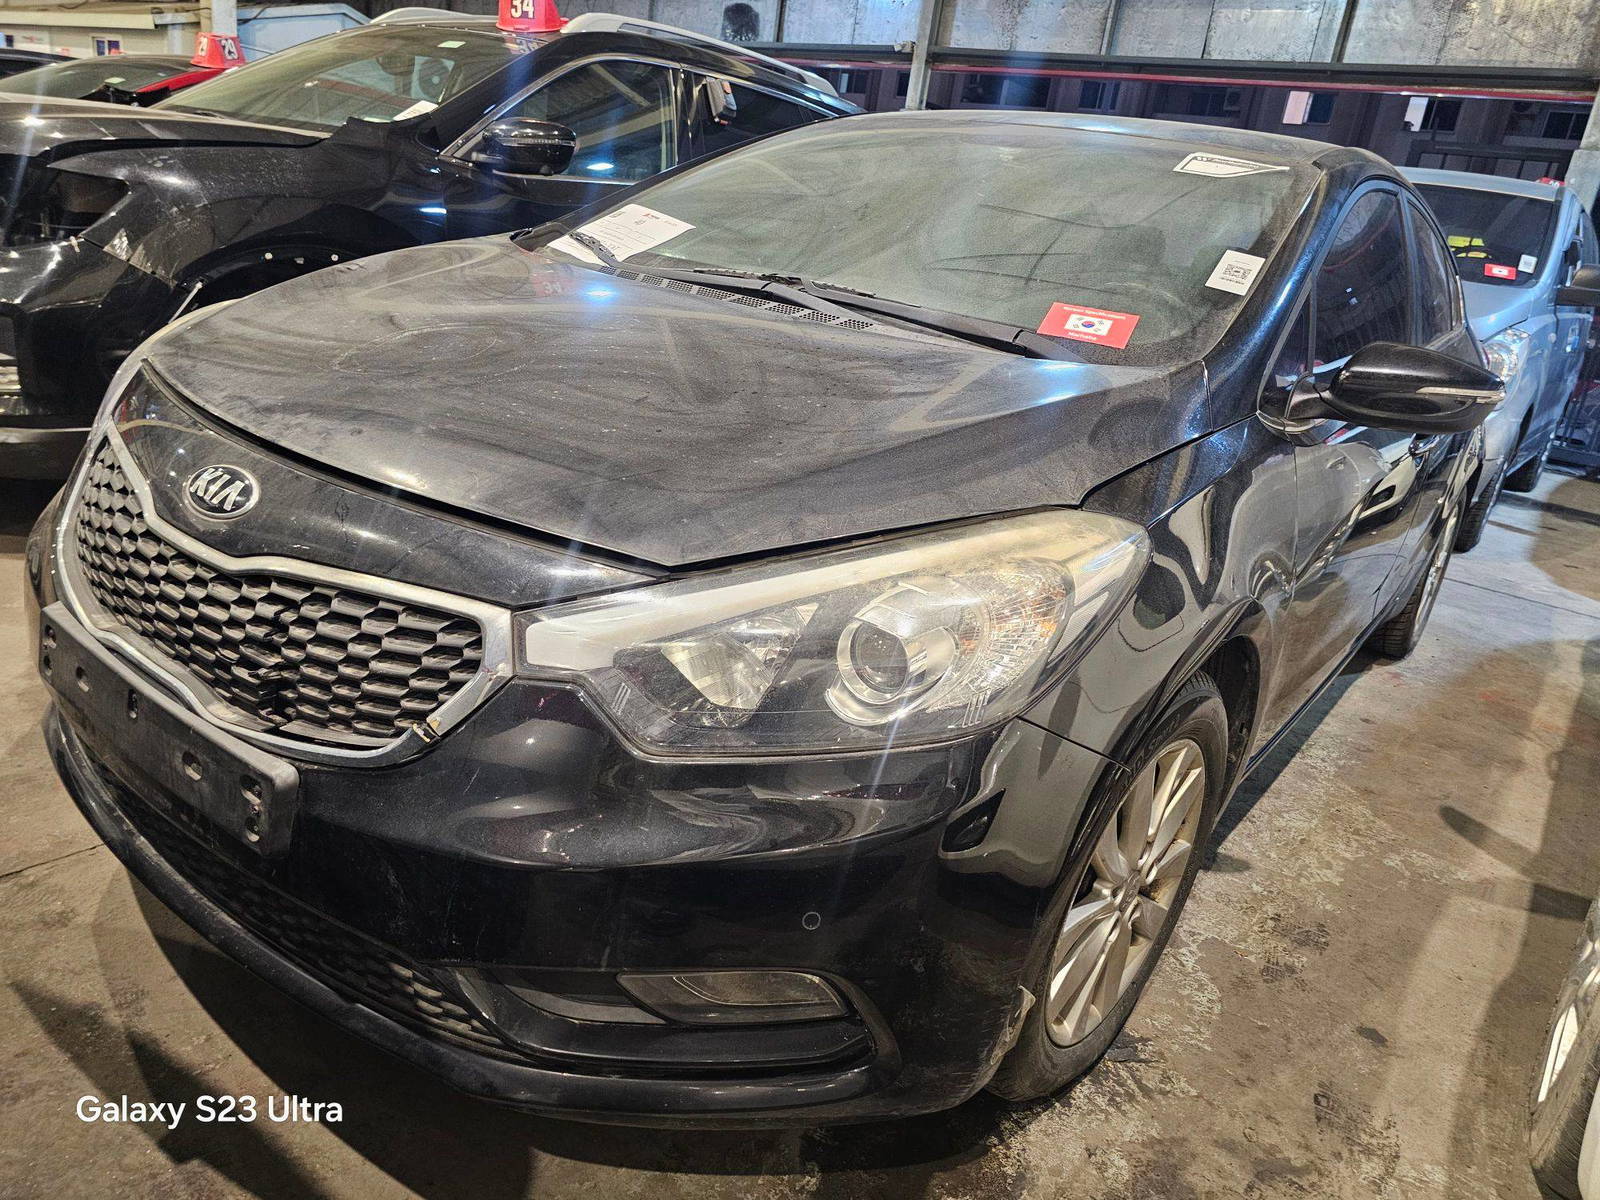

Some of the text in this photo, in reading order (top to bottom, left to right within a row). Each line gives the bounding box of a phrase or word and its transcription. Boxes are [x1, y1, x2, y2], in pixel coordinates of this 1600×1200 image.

[510, 0, 535, 19] 34
[219, 38, 238, 60] 29
[190, 468, 245, 511] KIA
